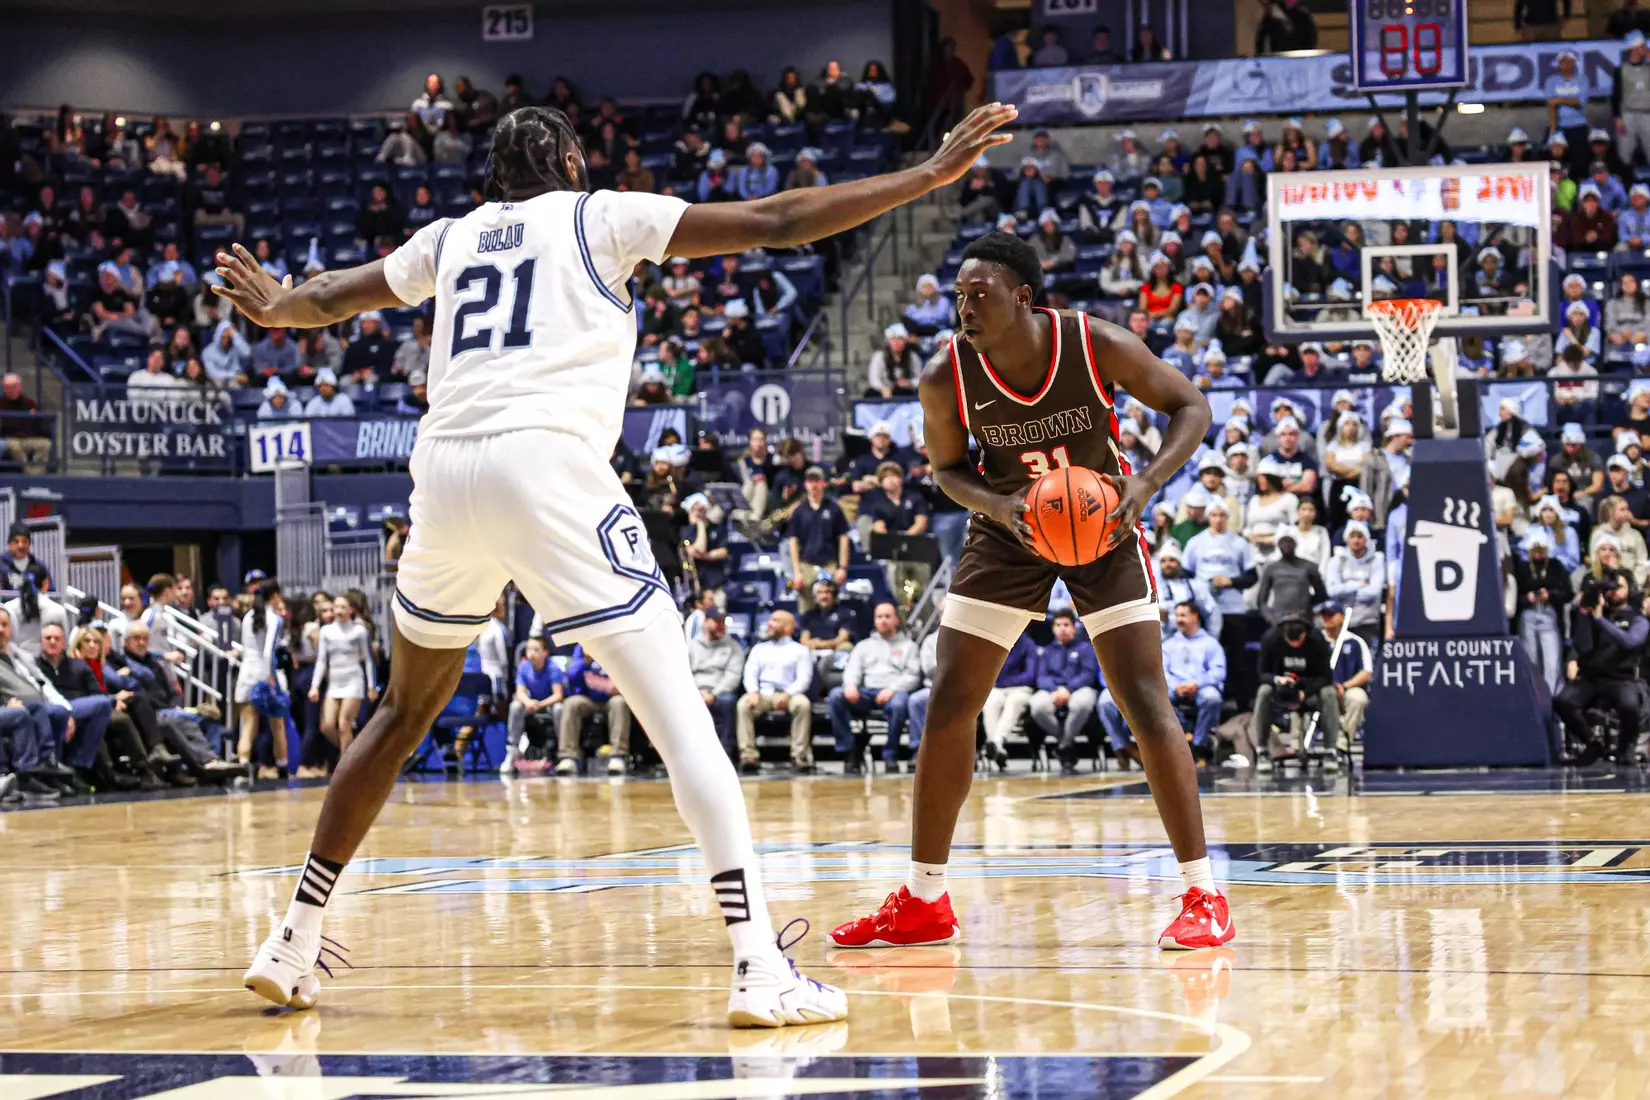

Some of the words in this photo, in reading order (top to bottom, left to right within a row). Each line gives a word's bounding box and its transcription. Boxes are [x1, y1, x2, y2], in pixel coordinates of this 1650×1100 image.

[488, 9, 528, 35] 215
[1380, 23, 1442, 77] 20
[477, 223, 524, 253] BILAU
[451, 257, 538, 361] 21
[75, 400, 221, 424] MATUNUCK
[982, 406, 1092, 447] BROWN
[72, 431, 169, 456] OYSTER
[176, 433, 226, 457] BAR
[256, 431, 305, 463] 114
[1020, 445, 1070, 479] 31
[1077, 487, 1087, 522] adidas
[1435, 560, 1464, 592] D
[1383, 641, 1439, 659] SOUTH
[1446, 640, 1514, 657] COUNTY
